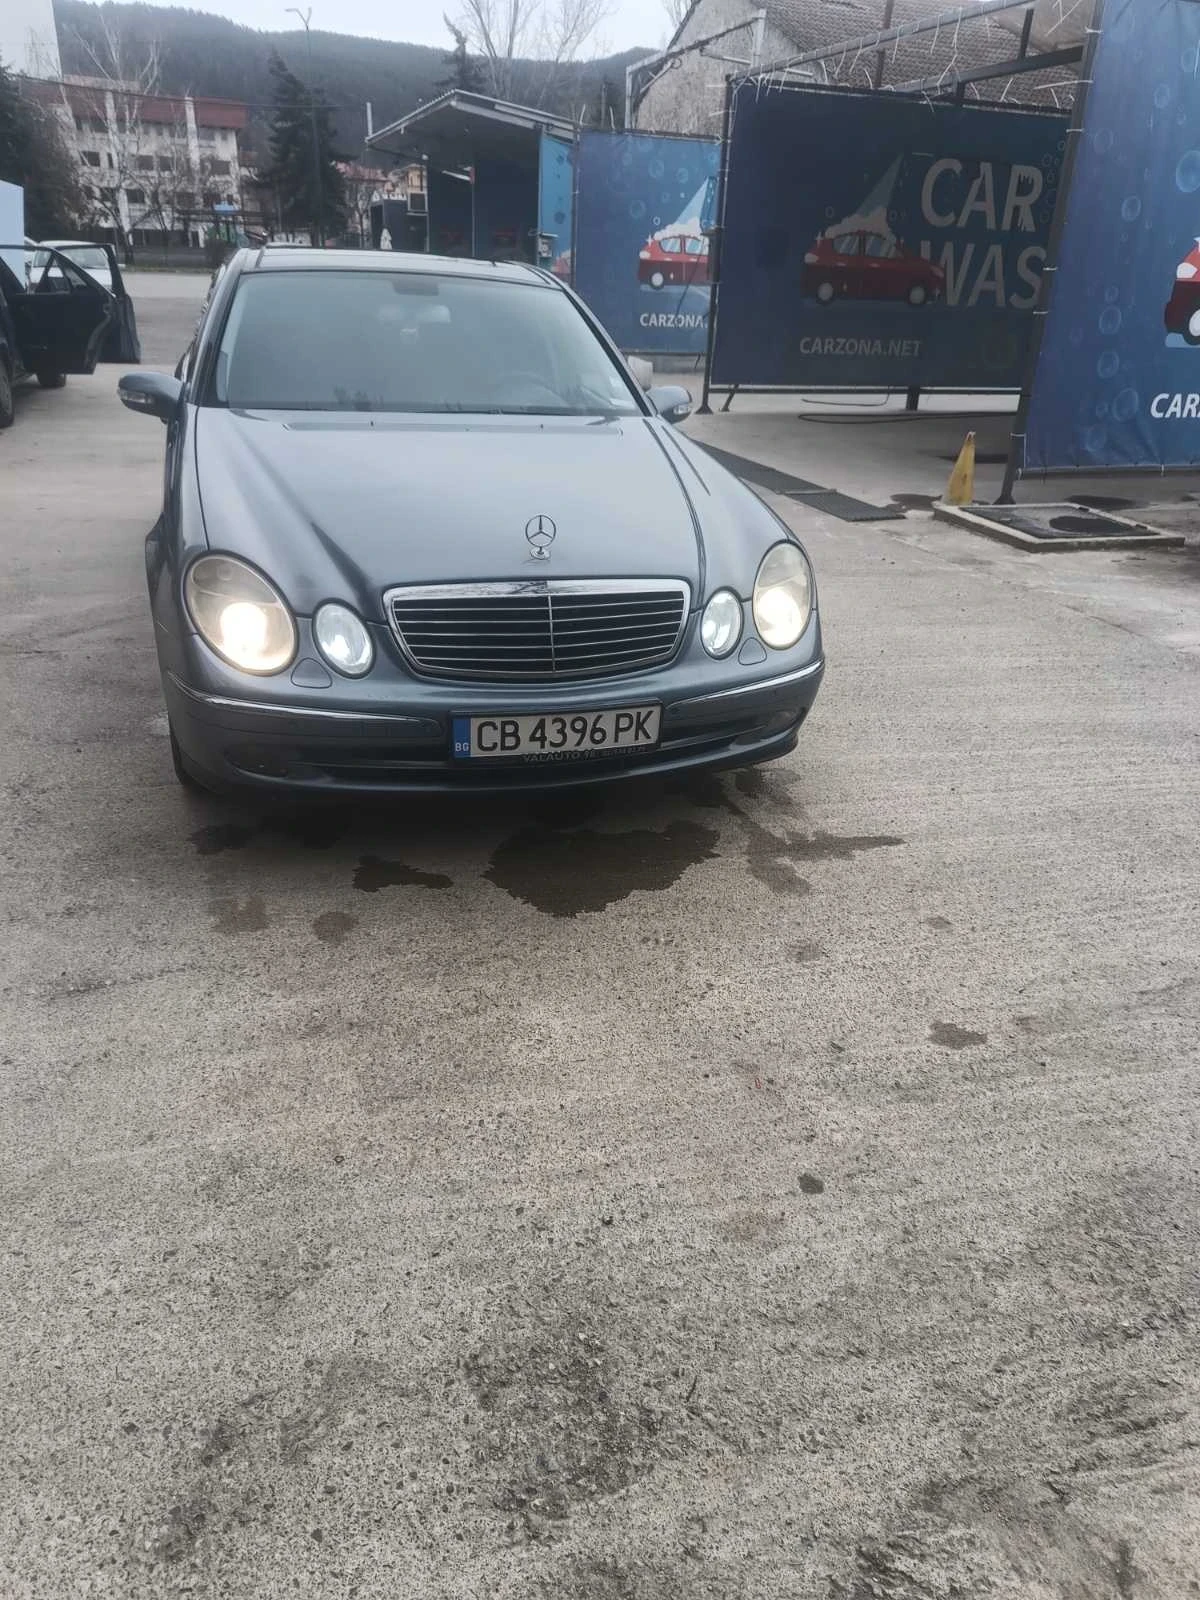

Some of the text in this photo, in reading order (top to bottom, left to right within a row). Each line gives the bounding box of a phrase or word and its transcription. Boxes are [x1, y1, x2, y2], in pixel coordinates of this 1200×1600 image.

[921, 158, 1043, 232] CAR
[799, 336, 921, 357] CARZONA.NET
[1150, 393, 1200, 418] CAR
[477, 710, 653, 752] CB 4396 PK
[455, 742, 470, 752] BG
